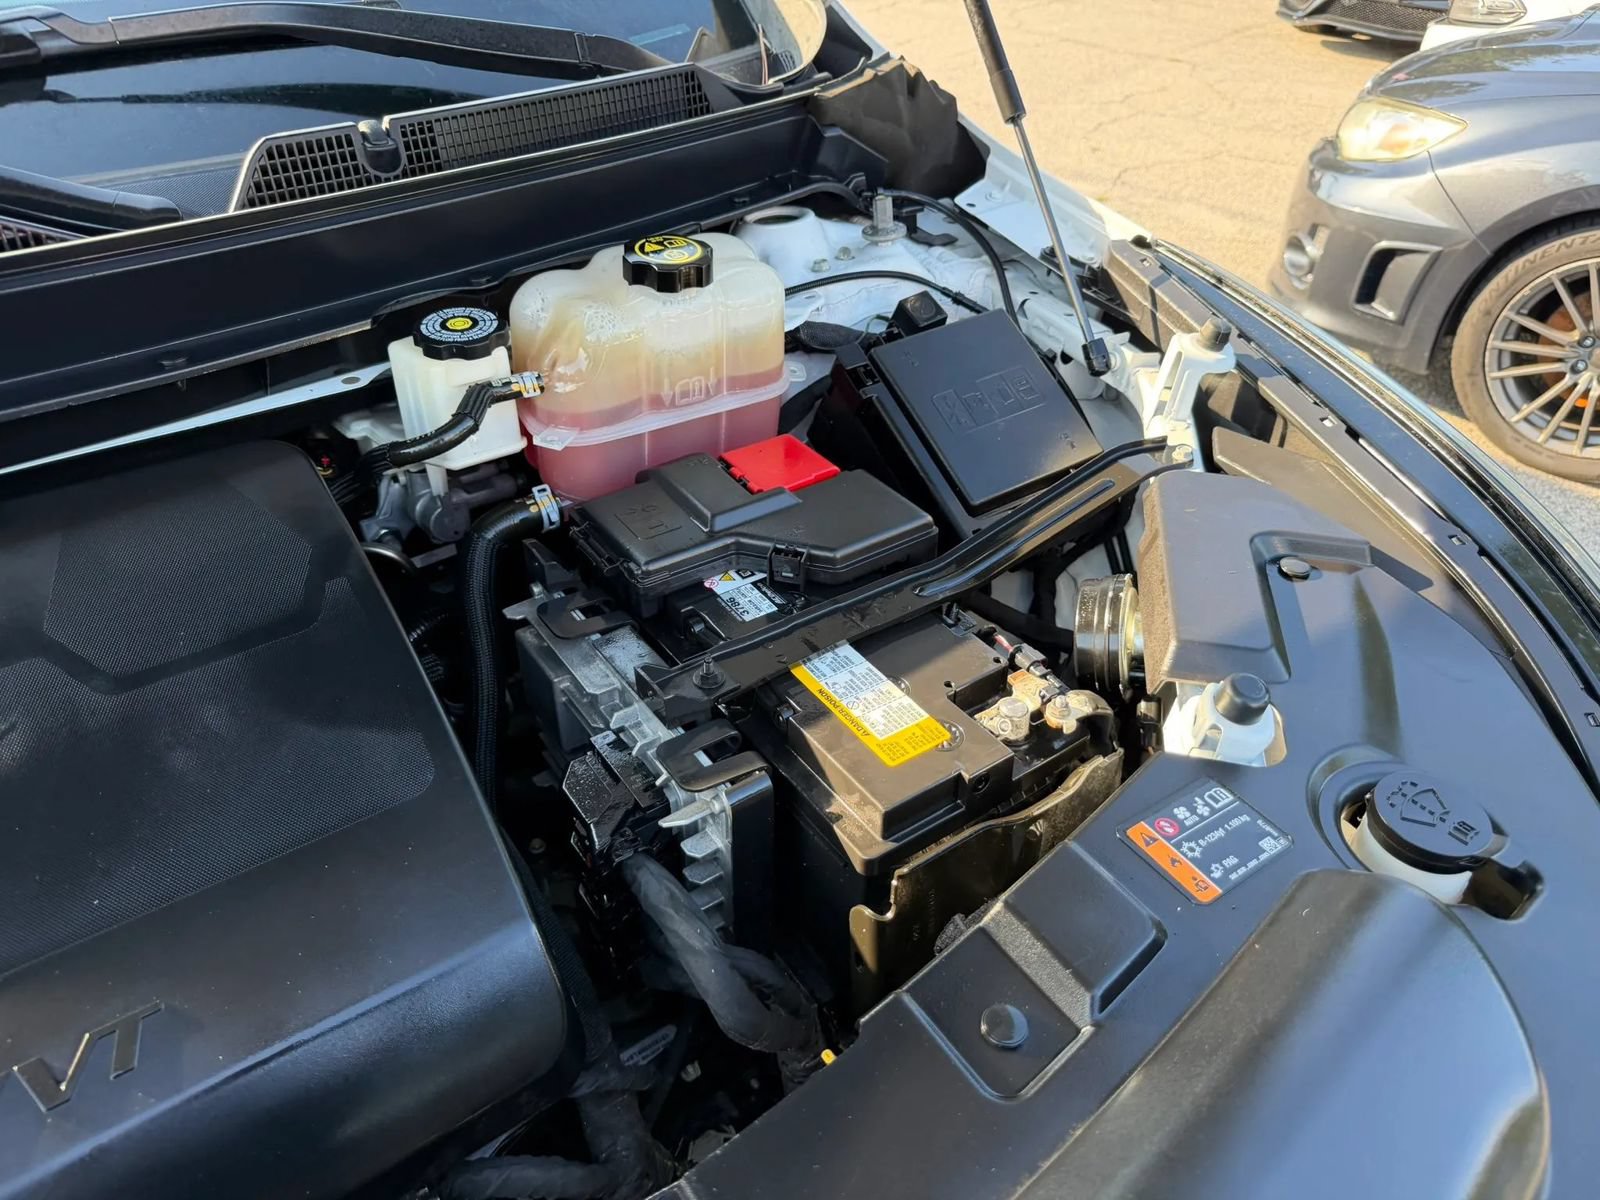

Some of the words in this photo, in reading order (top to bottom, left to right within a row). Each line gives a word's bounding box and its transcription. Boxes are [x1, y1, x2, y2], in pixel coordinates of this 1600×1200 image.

[726, 597, 750, 616] 3786
[1222, 855, 1240, 868] PAG
[0, 999, 164, 1113] VT
